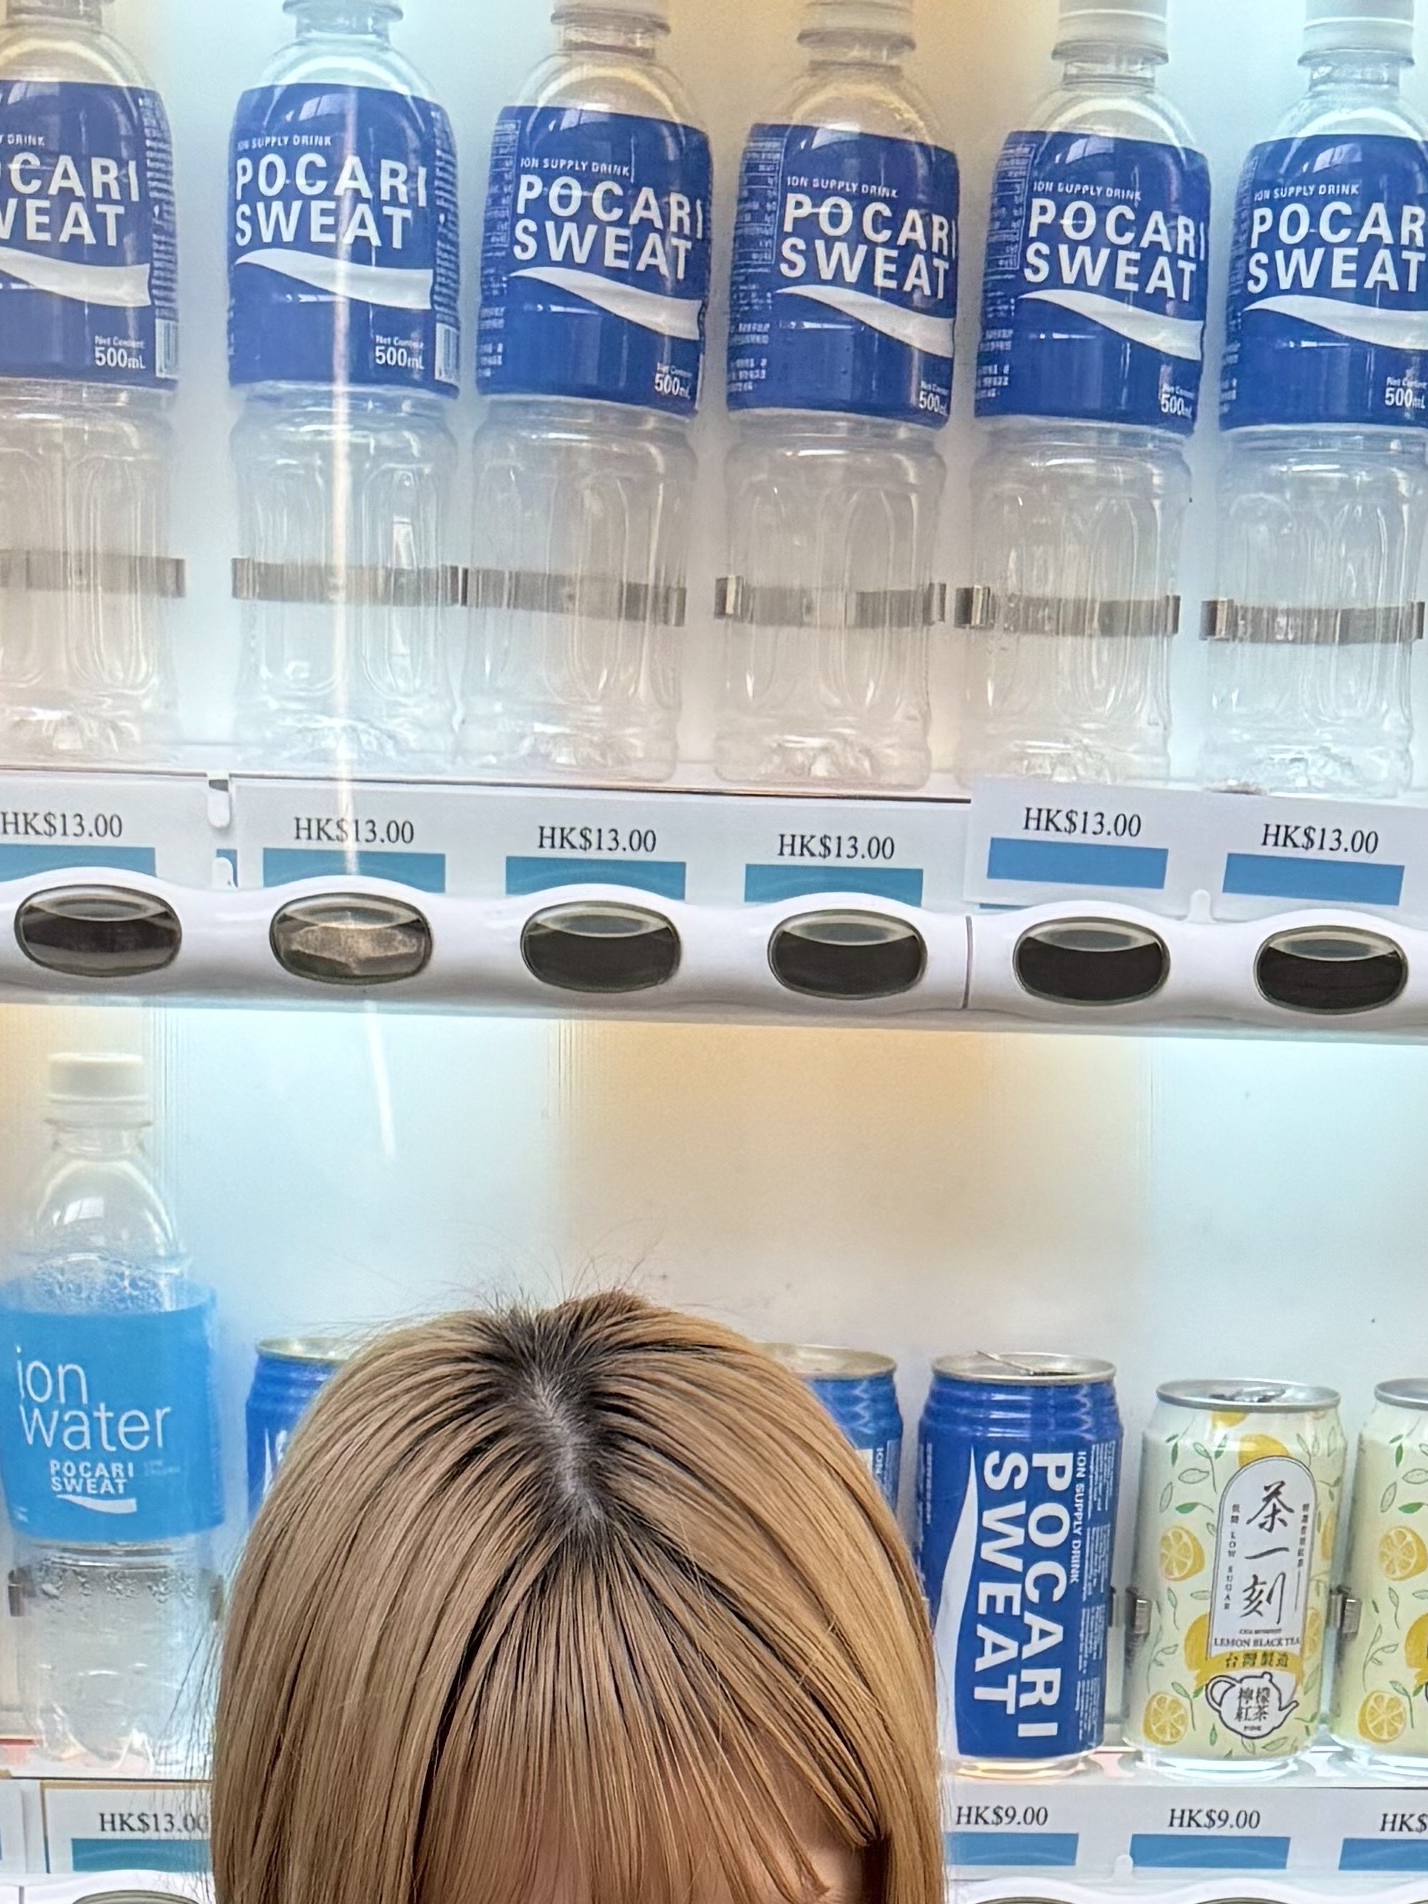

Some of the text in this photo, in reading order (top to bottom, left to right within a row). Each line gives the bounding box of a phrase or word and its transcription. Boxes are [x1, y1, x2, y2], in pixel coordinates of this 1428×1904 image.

[237, 148, 426, 212] POCARI
[1254, 184, 1359, 200] ION SUPPLY DRINK
[236, 194, 411, 255] SWEAT
[515, 173, 702, 244] POCARI
[1029, 199, 1204, 265] POCARI
[514, 219, 691, 285] SWEAT
[1024, 242, 1196, 300] SWEAT
[1248, 247, 1425, 293] SWEAT
[375, 345, 424, 371] 500mL
[1384, 387, 1426, 410] 500mL
[1, 812, 122, 837] HK$13.00
[295, 817, 414, 844] HK$13.00
[538, 826, 656, 852] HK$13.00
[1024, 807, 1141, 837] HK$13.00
[1262, 824, 1378, 854] HK$13.00
[778, 834, 894, 859] HK$13.00
[16, 1345, 87, 1404] ion
[20, 1403, 171, 1452] water
[49, 1459, 134, 1478] POCARI
[51, 1477, 127, 1495] SWEAT
[1070, 1451, 1086, 1583] ION SUPPLY DRINK
[1240, 1481, 1295, 1625] 茶一刻
[975, 1451, 1028, 1715] SWEAT
[1018, 1453, 1073, 1737] POCARI
[956, 1805, 1048, 1826] HK$9.00
[1169, 1808, 1260, 1829] HK$9.00
